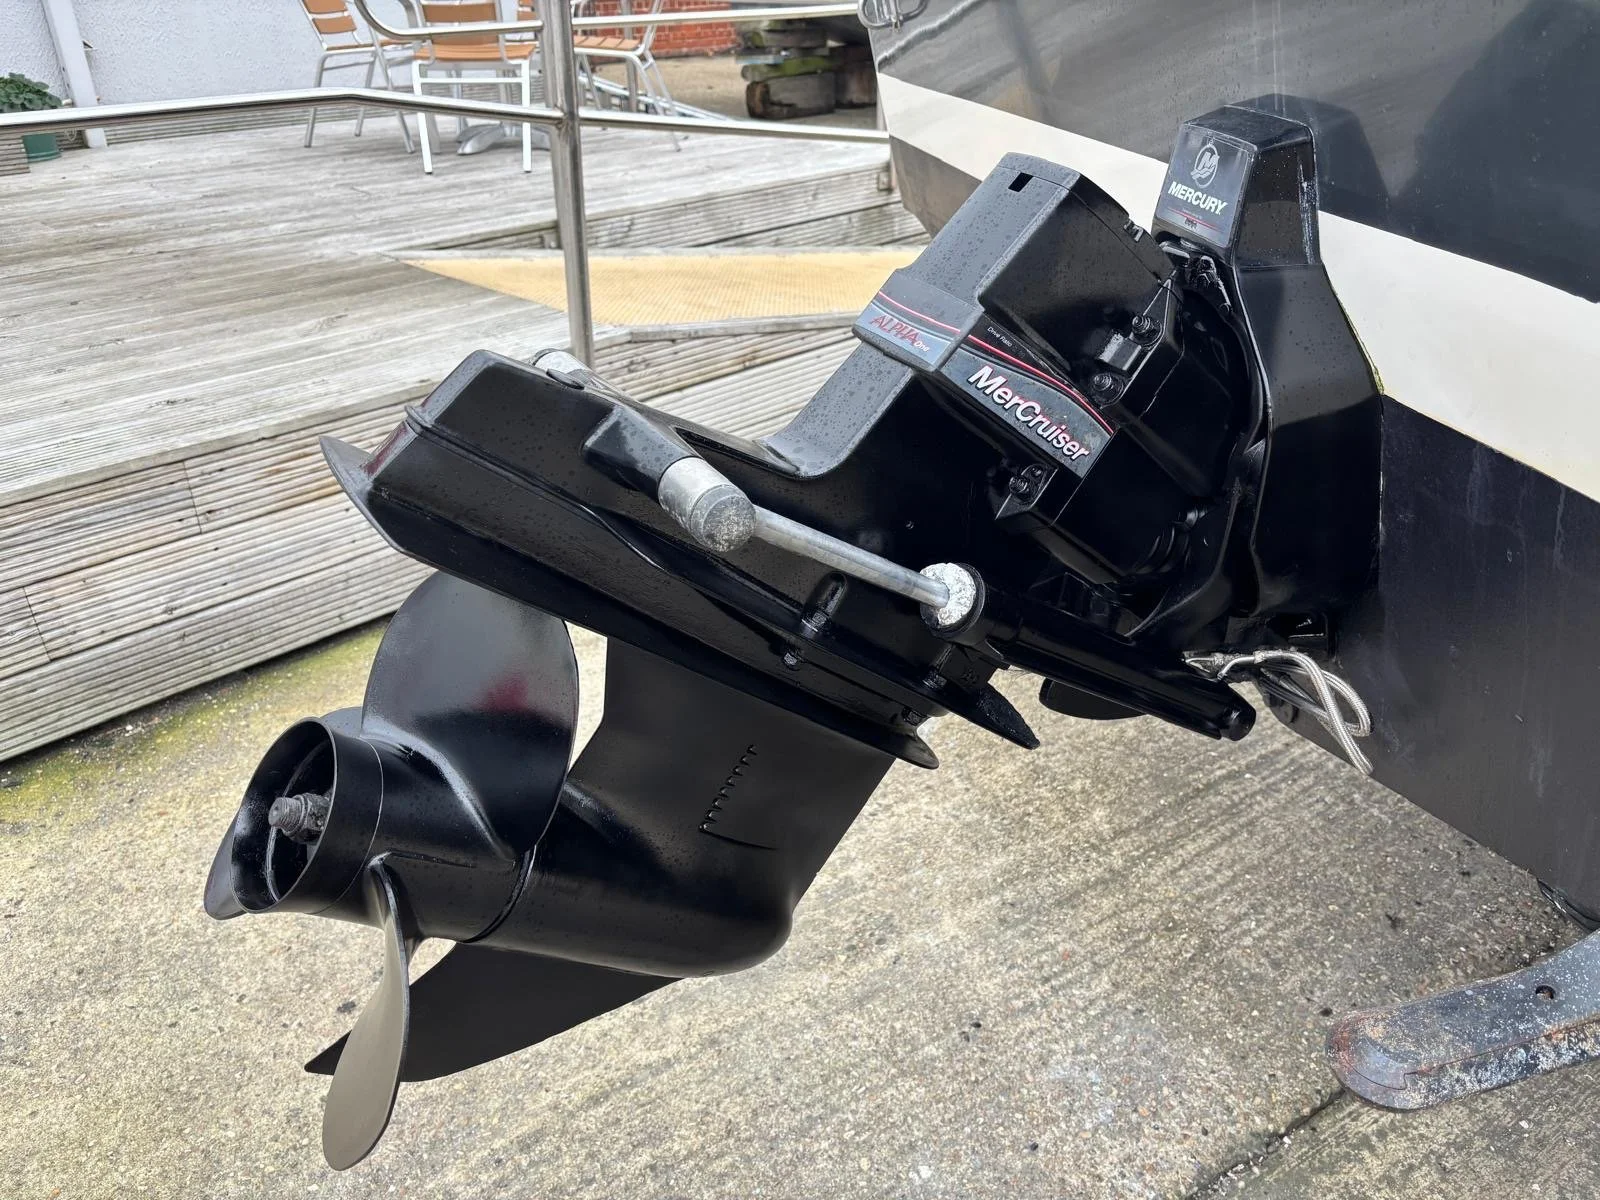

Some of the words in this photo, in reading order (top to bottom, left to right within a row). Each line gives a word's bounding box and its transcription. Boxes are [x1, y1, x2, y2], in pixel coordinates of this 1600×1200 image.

[1167, 181, 1228, 215] MERCURY
[869, 315, 920, 346] ALPHA
[913, 340, 930, 352] One
[987, 326, 1001, 338] Drive
[1000, 336, 1013, 347] Ratio
[967, 365, 1090, 461] MerCruiser
